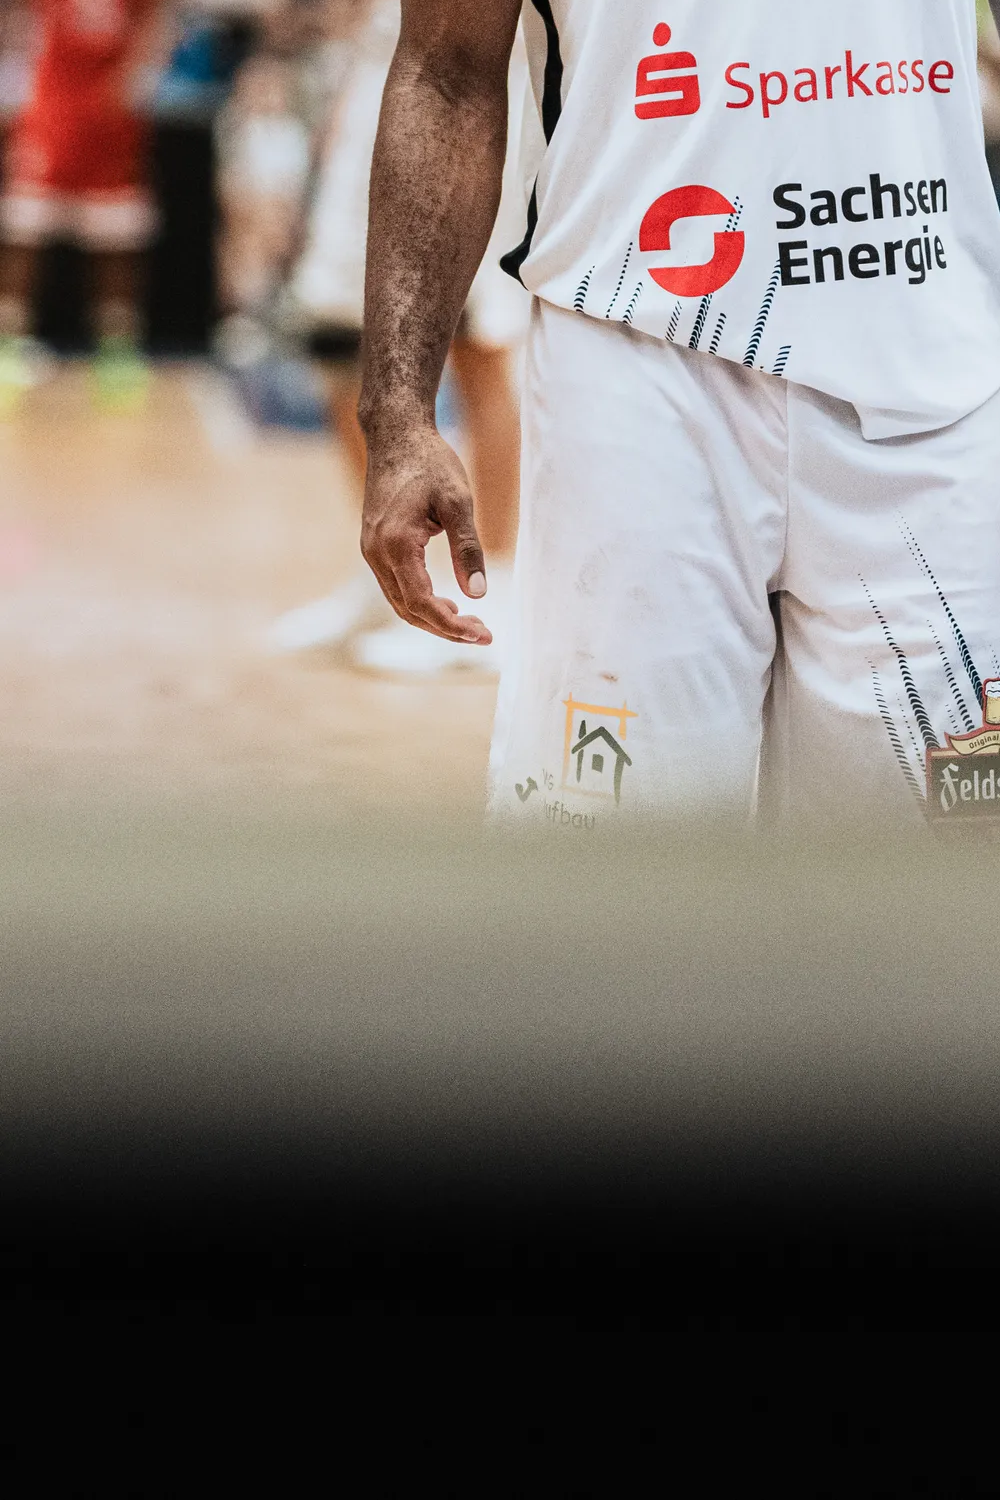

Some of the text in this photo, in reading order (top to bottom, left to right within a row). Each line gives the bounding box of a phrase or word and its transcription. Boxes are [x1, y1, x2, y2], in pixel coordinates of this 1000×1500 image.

[724, 50, 955, 119] Sparkasse
[772, 173, 948, 230] Sachsen
[777, 225, 948, 287] Energie
[968, 733, 1000, 750] Original
